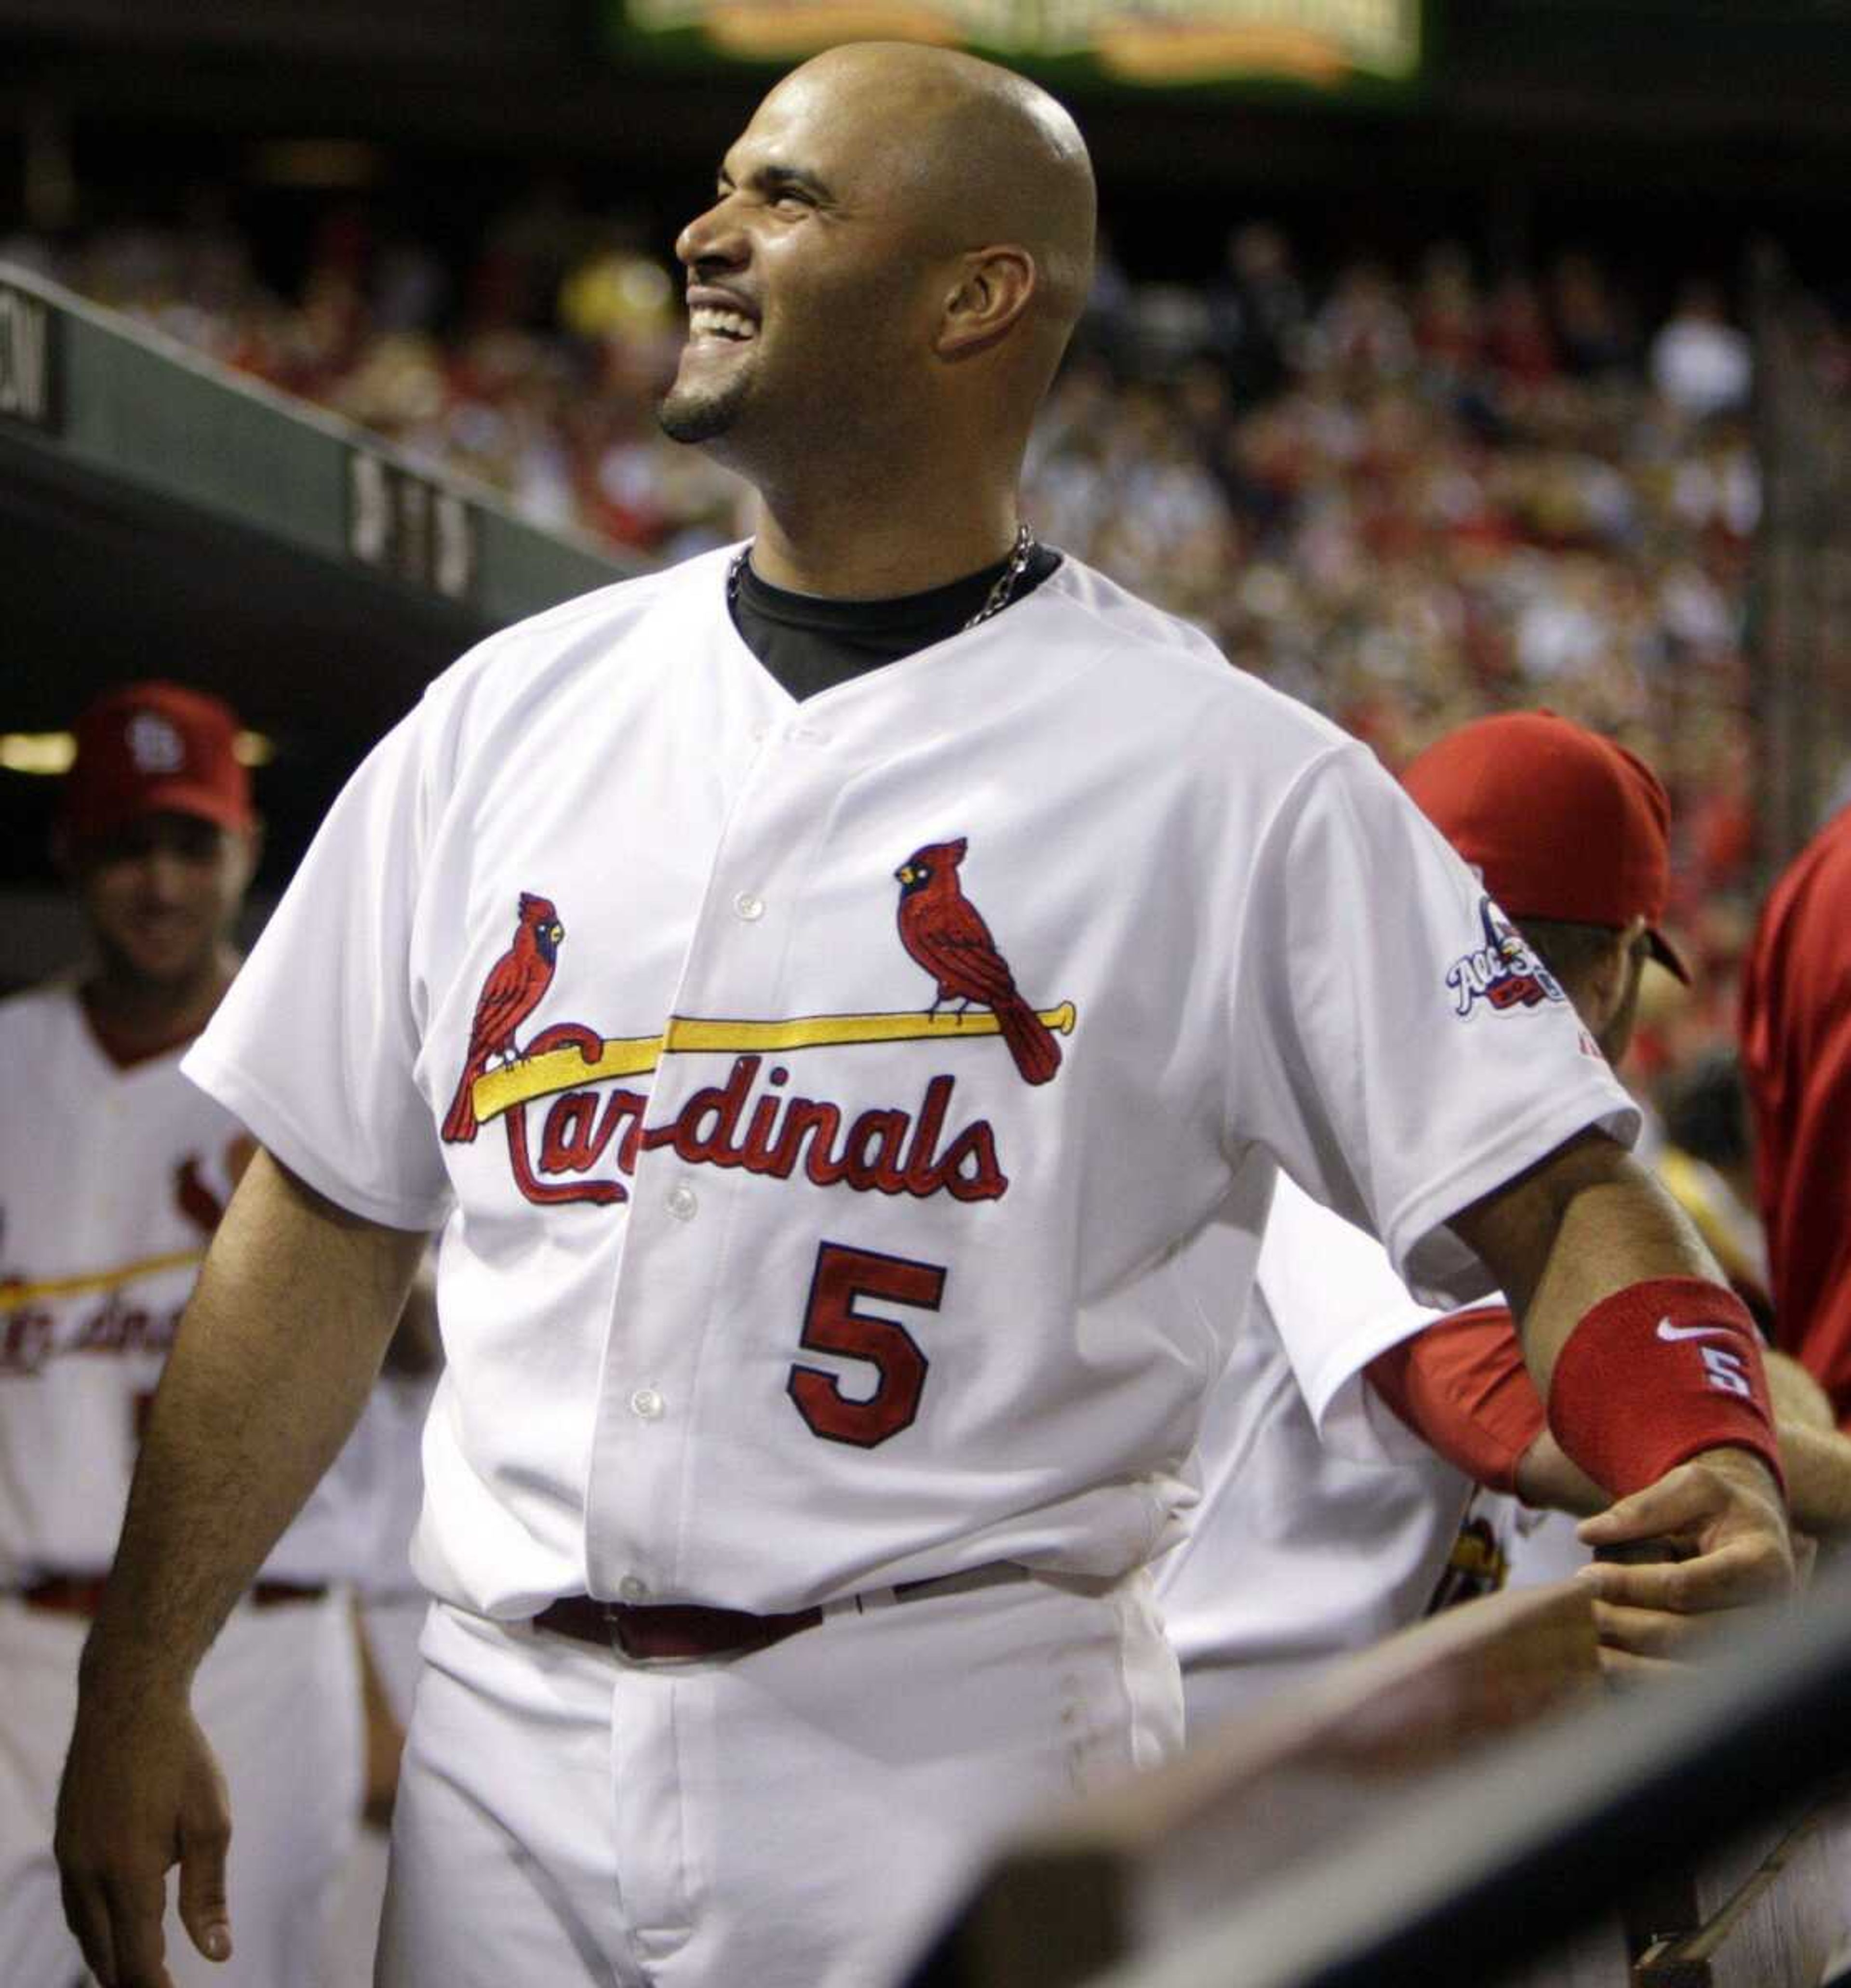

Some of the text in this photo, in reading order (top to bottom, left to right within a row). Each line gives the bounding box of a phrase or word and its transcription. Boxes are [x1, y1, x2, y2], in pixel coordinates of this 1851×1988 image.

[504, 1022, 1008, 1206] Cardinals
[787, 1240, 947, 1450] 5
[1700, 1346, 1751, 1397] 5
